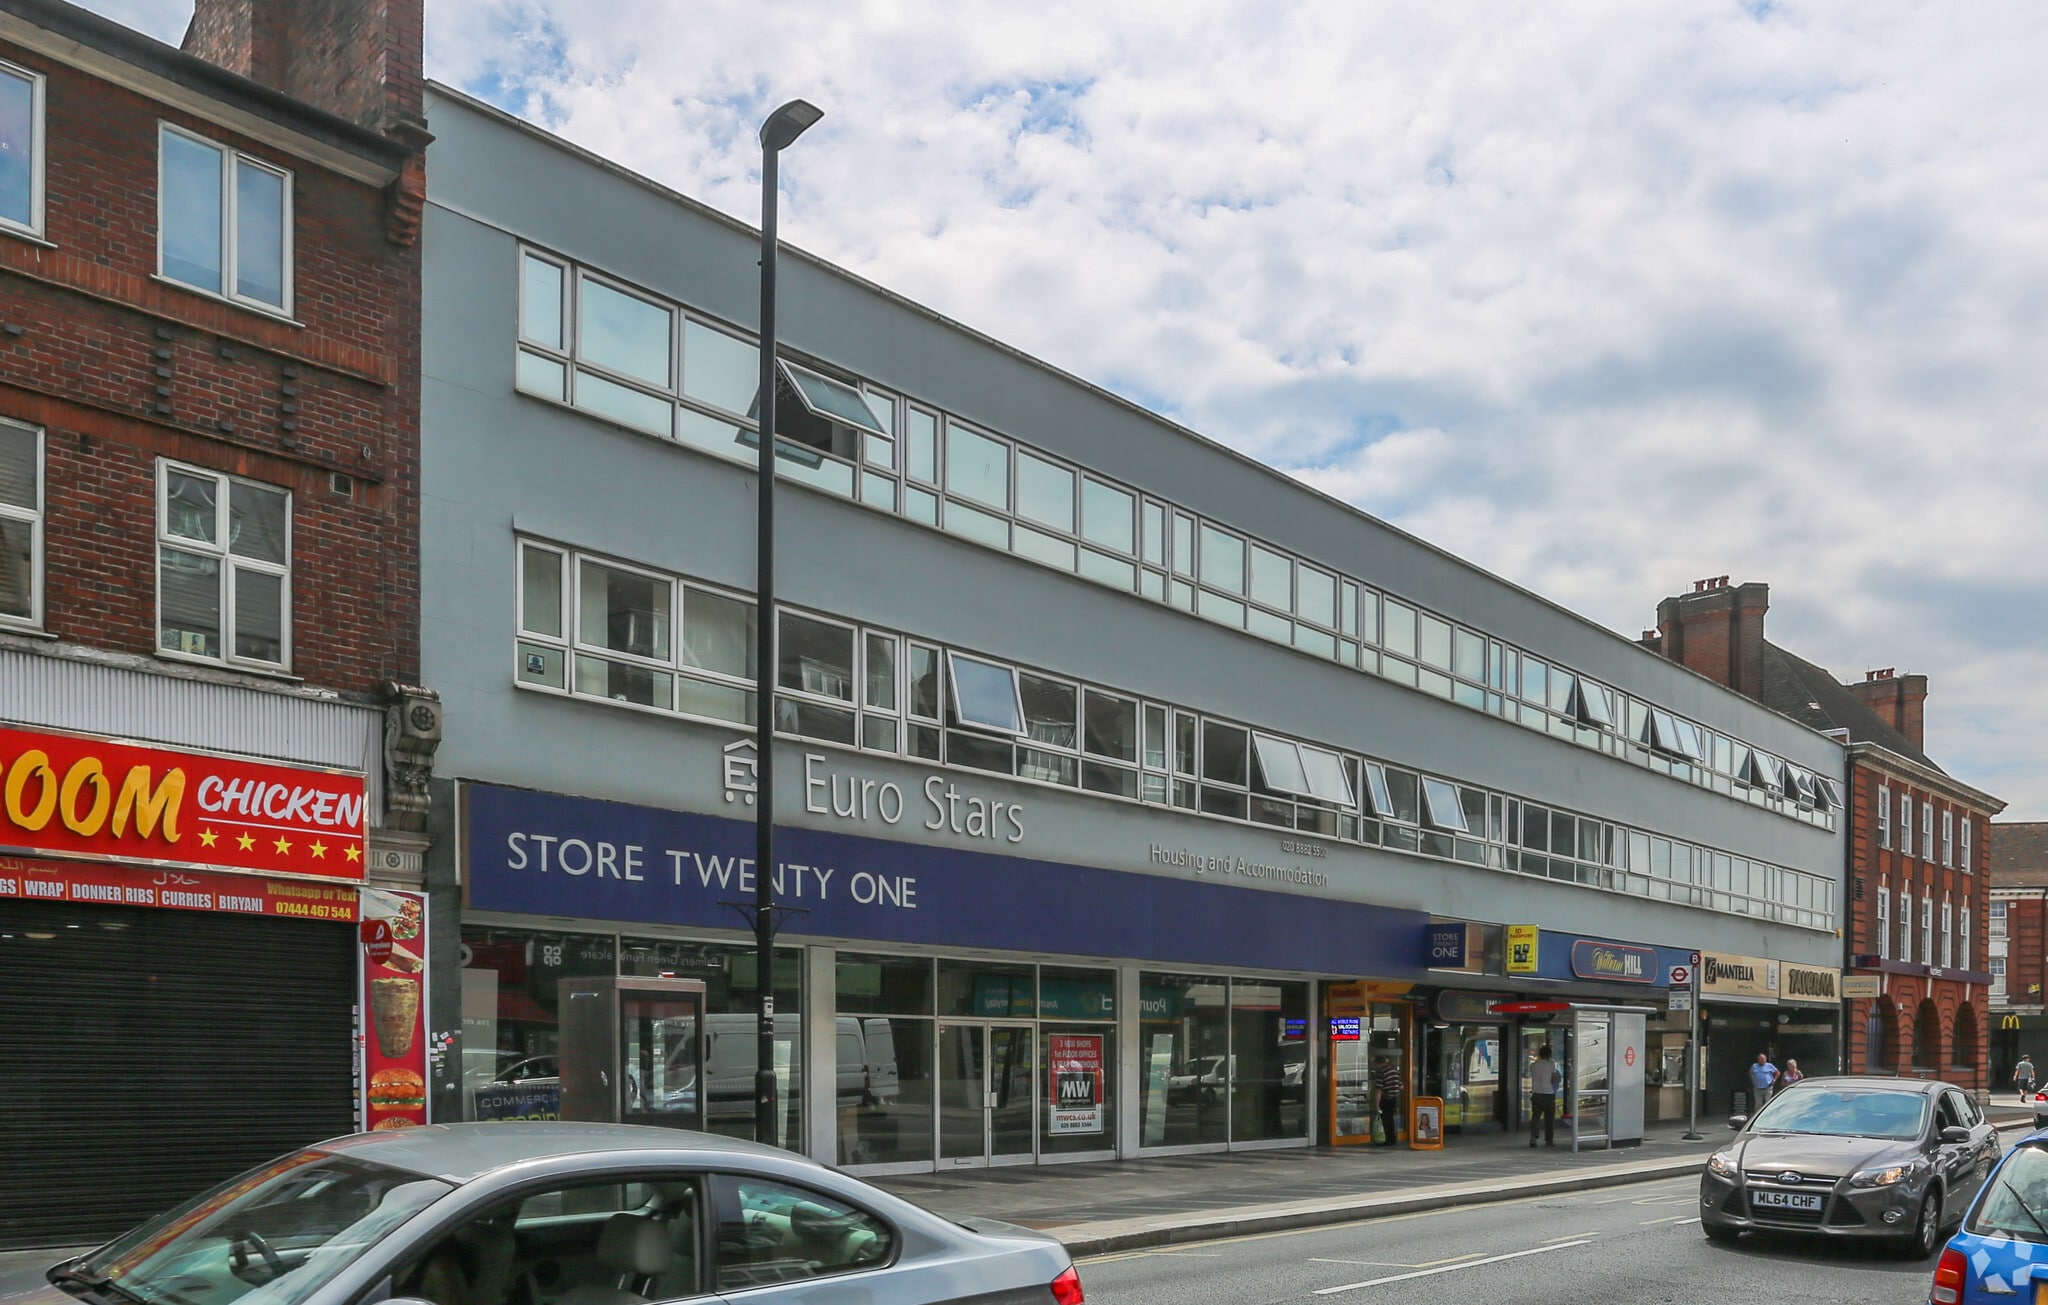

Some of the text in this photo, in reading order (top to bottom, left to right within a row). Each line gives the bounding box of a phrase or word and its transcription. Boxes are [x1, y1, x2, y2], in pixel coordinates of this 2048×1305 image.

[0, 749, 186, 843] OOM
[198, 775, 362, 828] CHICKEN
[806, 753, 1024, 843] Euro Stars
[508, 832, 644, 881] STORE
[850, 872, 917, 908] ONE
[1151, 843, 1329, 887] Housing and Accommodation
[25, 880, 64, 897] WRAP
[72, 884, 122, 901] DONNER
[125, 887, 154, 903] RIBS
[161, 890, 212, 908] CURRIES
[219, 895, 263, 912] BIRYANI
[267, 883, 357, 902] Whatsapp or Text
[276, 902, 351, 919] 07444 467 544
[1432, 946, 1459, 958] ONE
[1692, 954, 1699, 965] B
[1717, 963, 1754, 981] MANTELLA
[1062, 1081, 1090, 1098] MW
[1056, 1112, 1096, 1121] mwcs.co.uk
[1792, 1195, 1816, 1208] CHF
